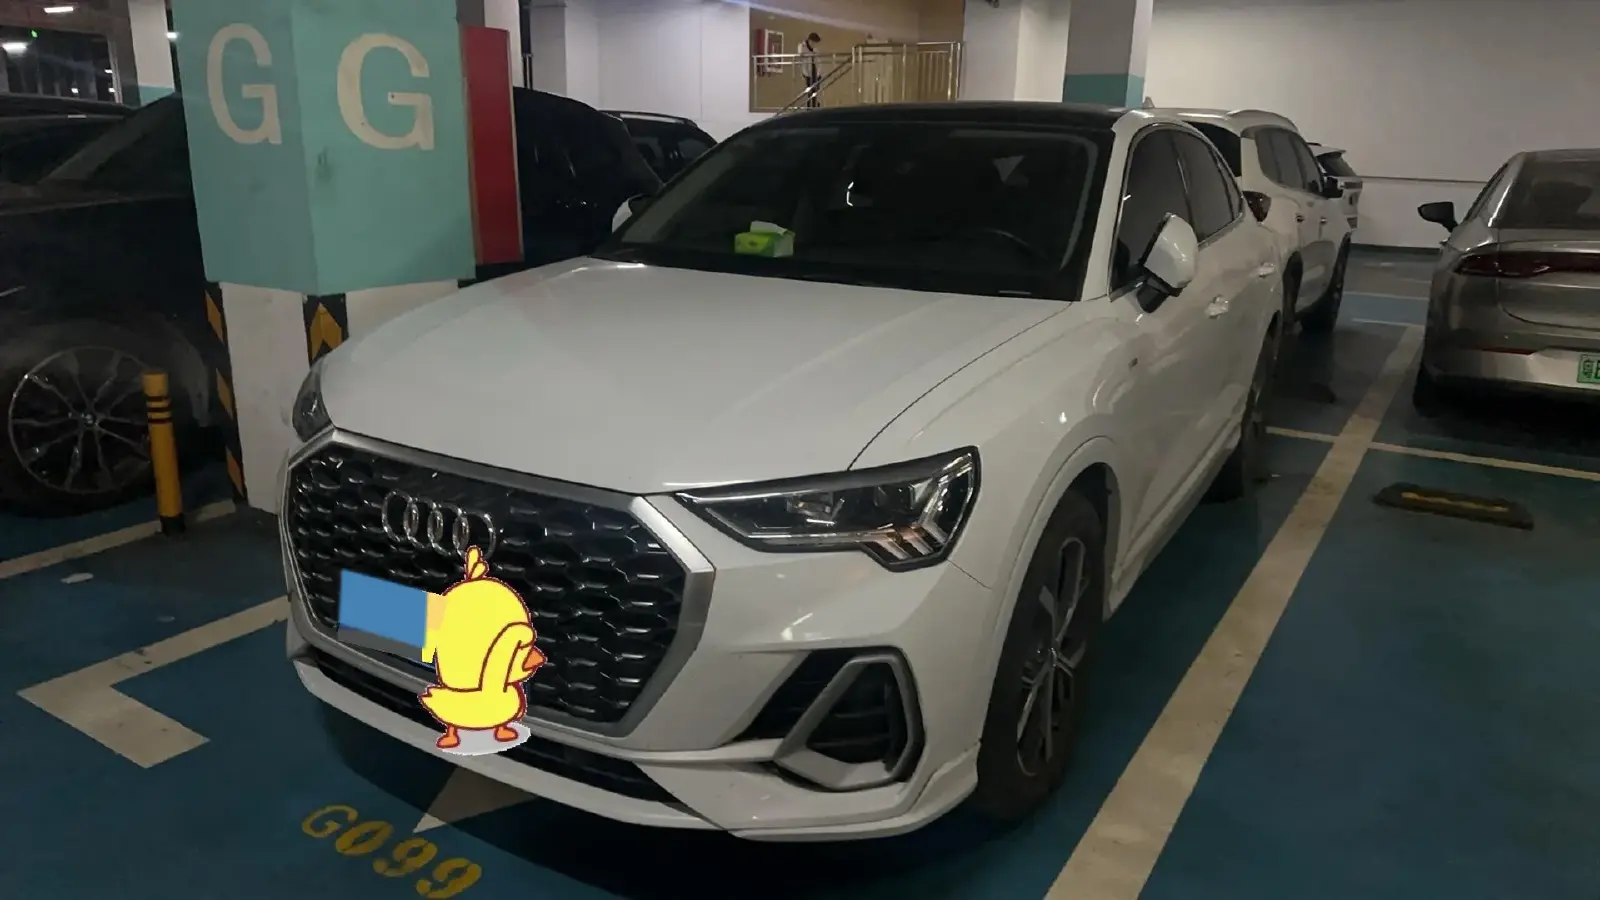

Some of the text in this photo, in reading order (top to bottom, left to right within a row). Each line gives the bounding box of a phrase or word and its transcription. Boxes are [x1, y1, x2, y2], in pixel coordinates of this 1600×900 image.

[206, 23, 282, 145] G
[337, 33, 435, 150] G
[301, 804, 482, 899] G099
